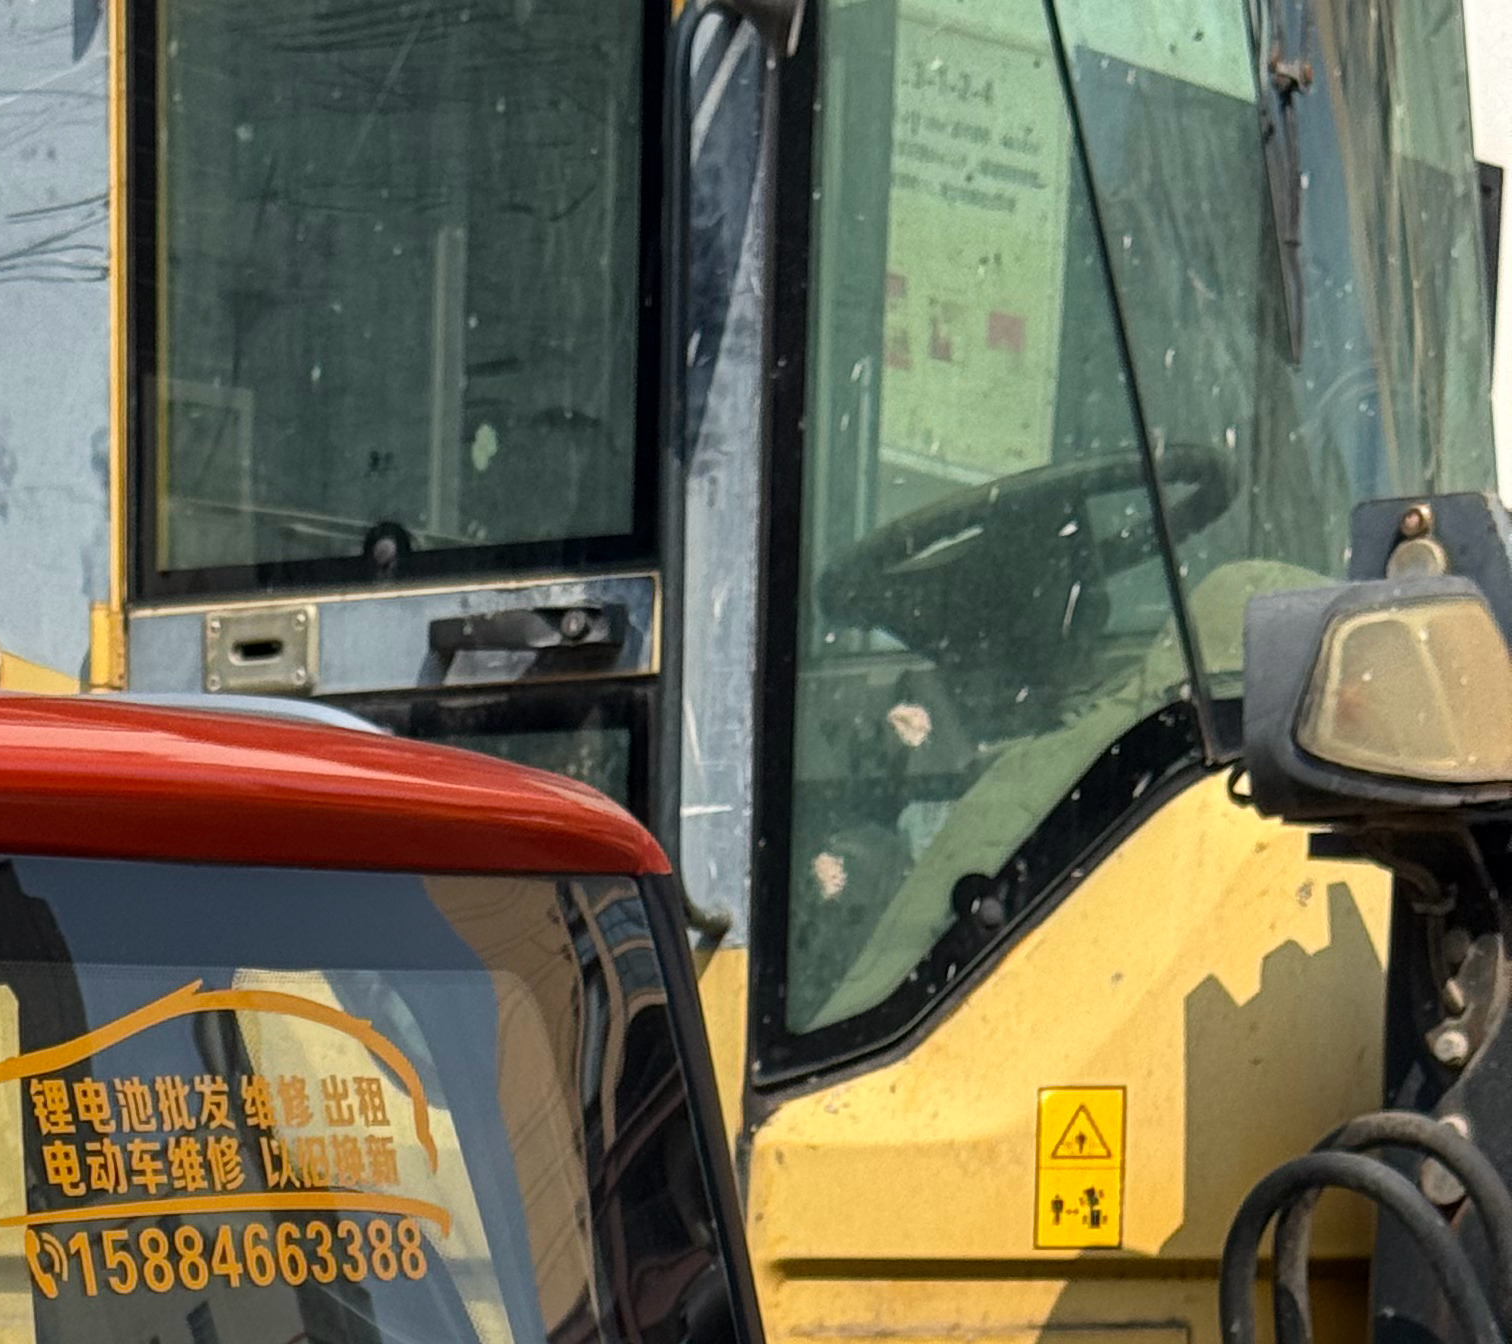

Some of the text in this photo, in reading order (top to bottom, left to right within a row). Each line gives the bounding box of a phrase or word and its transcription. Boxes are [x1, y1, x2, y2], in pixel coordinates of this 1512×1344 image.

[30, 1073, 391, 1136] 锂电池批发 维修 出租
[42, 1133, 400, 1197] 电动车维修 以旧换新
[69, 1221, 428, 1297] 15884663388
